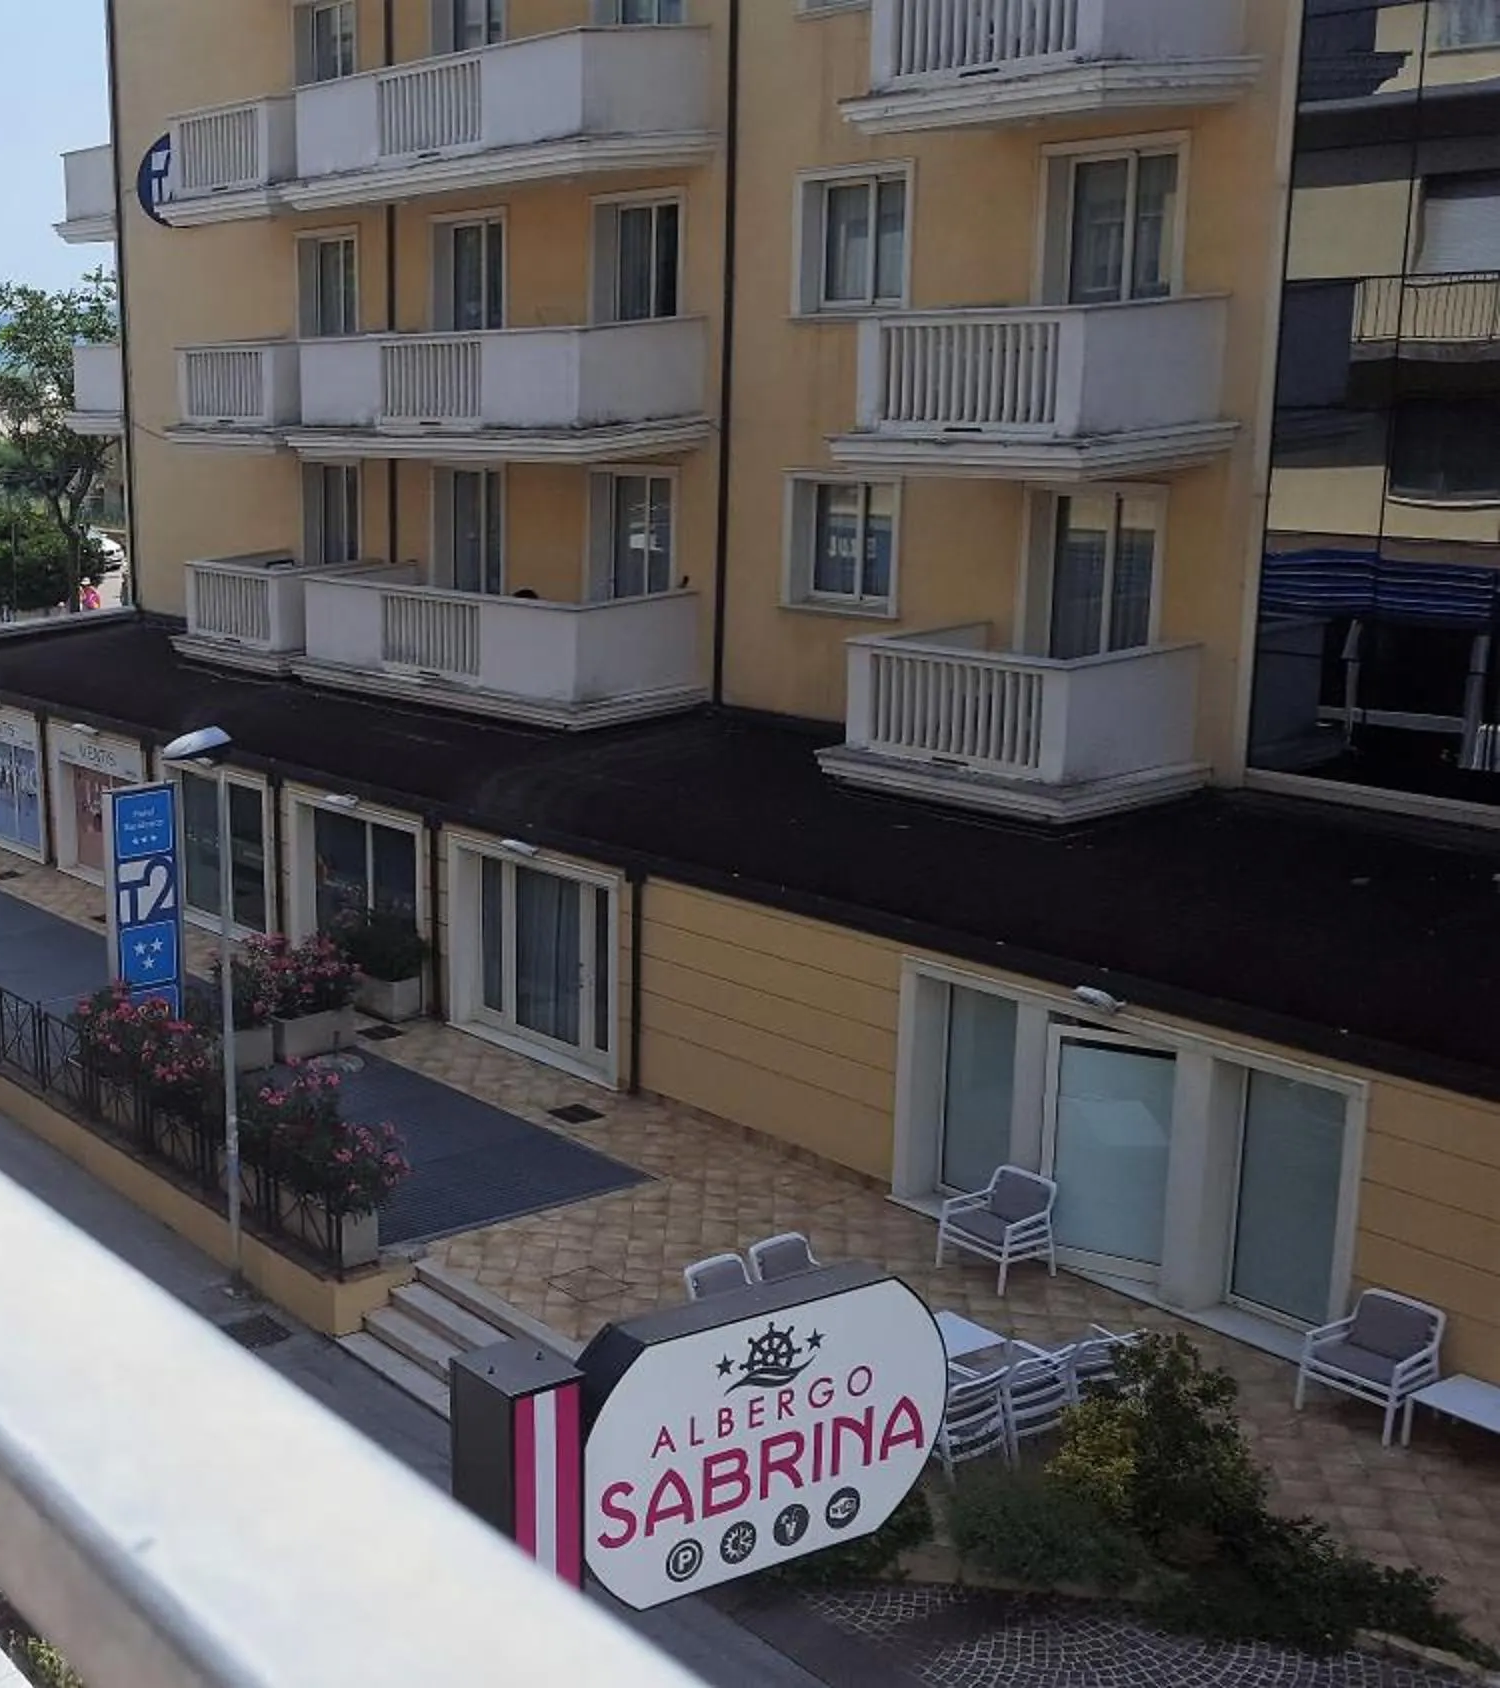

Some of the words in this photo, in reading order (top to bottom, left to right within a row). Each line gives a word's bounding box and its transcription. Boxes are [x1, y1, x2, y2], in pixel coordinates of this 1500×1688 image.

[117, 855, 176, 924] T2
[650, 1364, 875, 1459] ALBERGO
[596, 1395, 926, 1550] SABRINA
